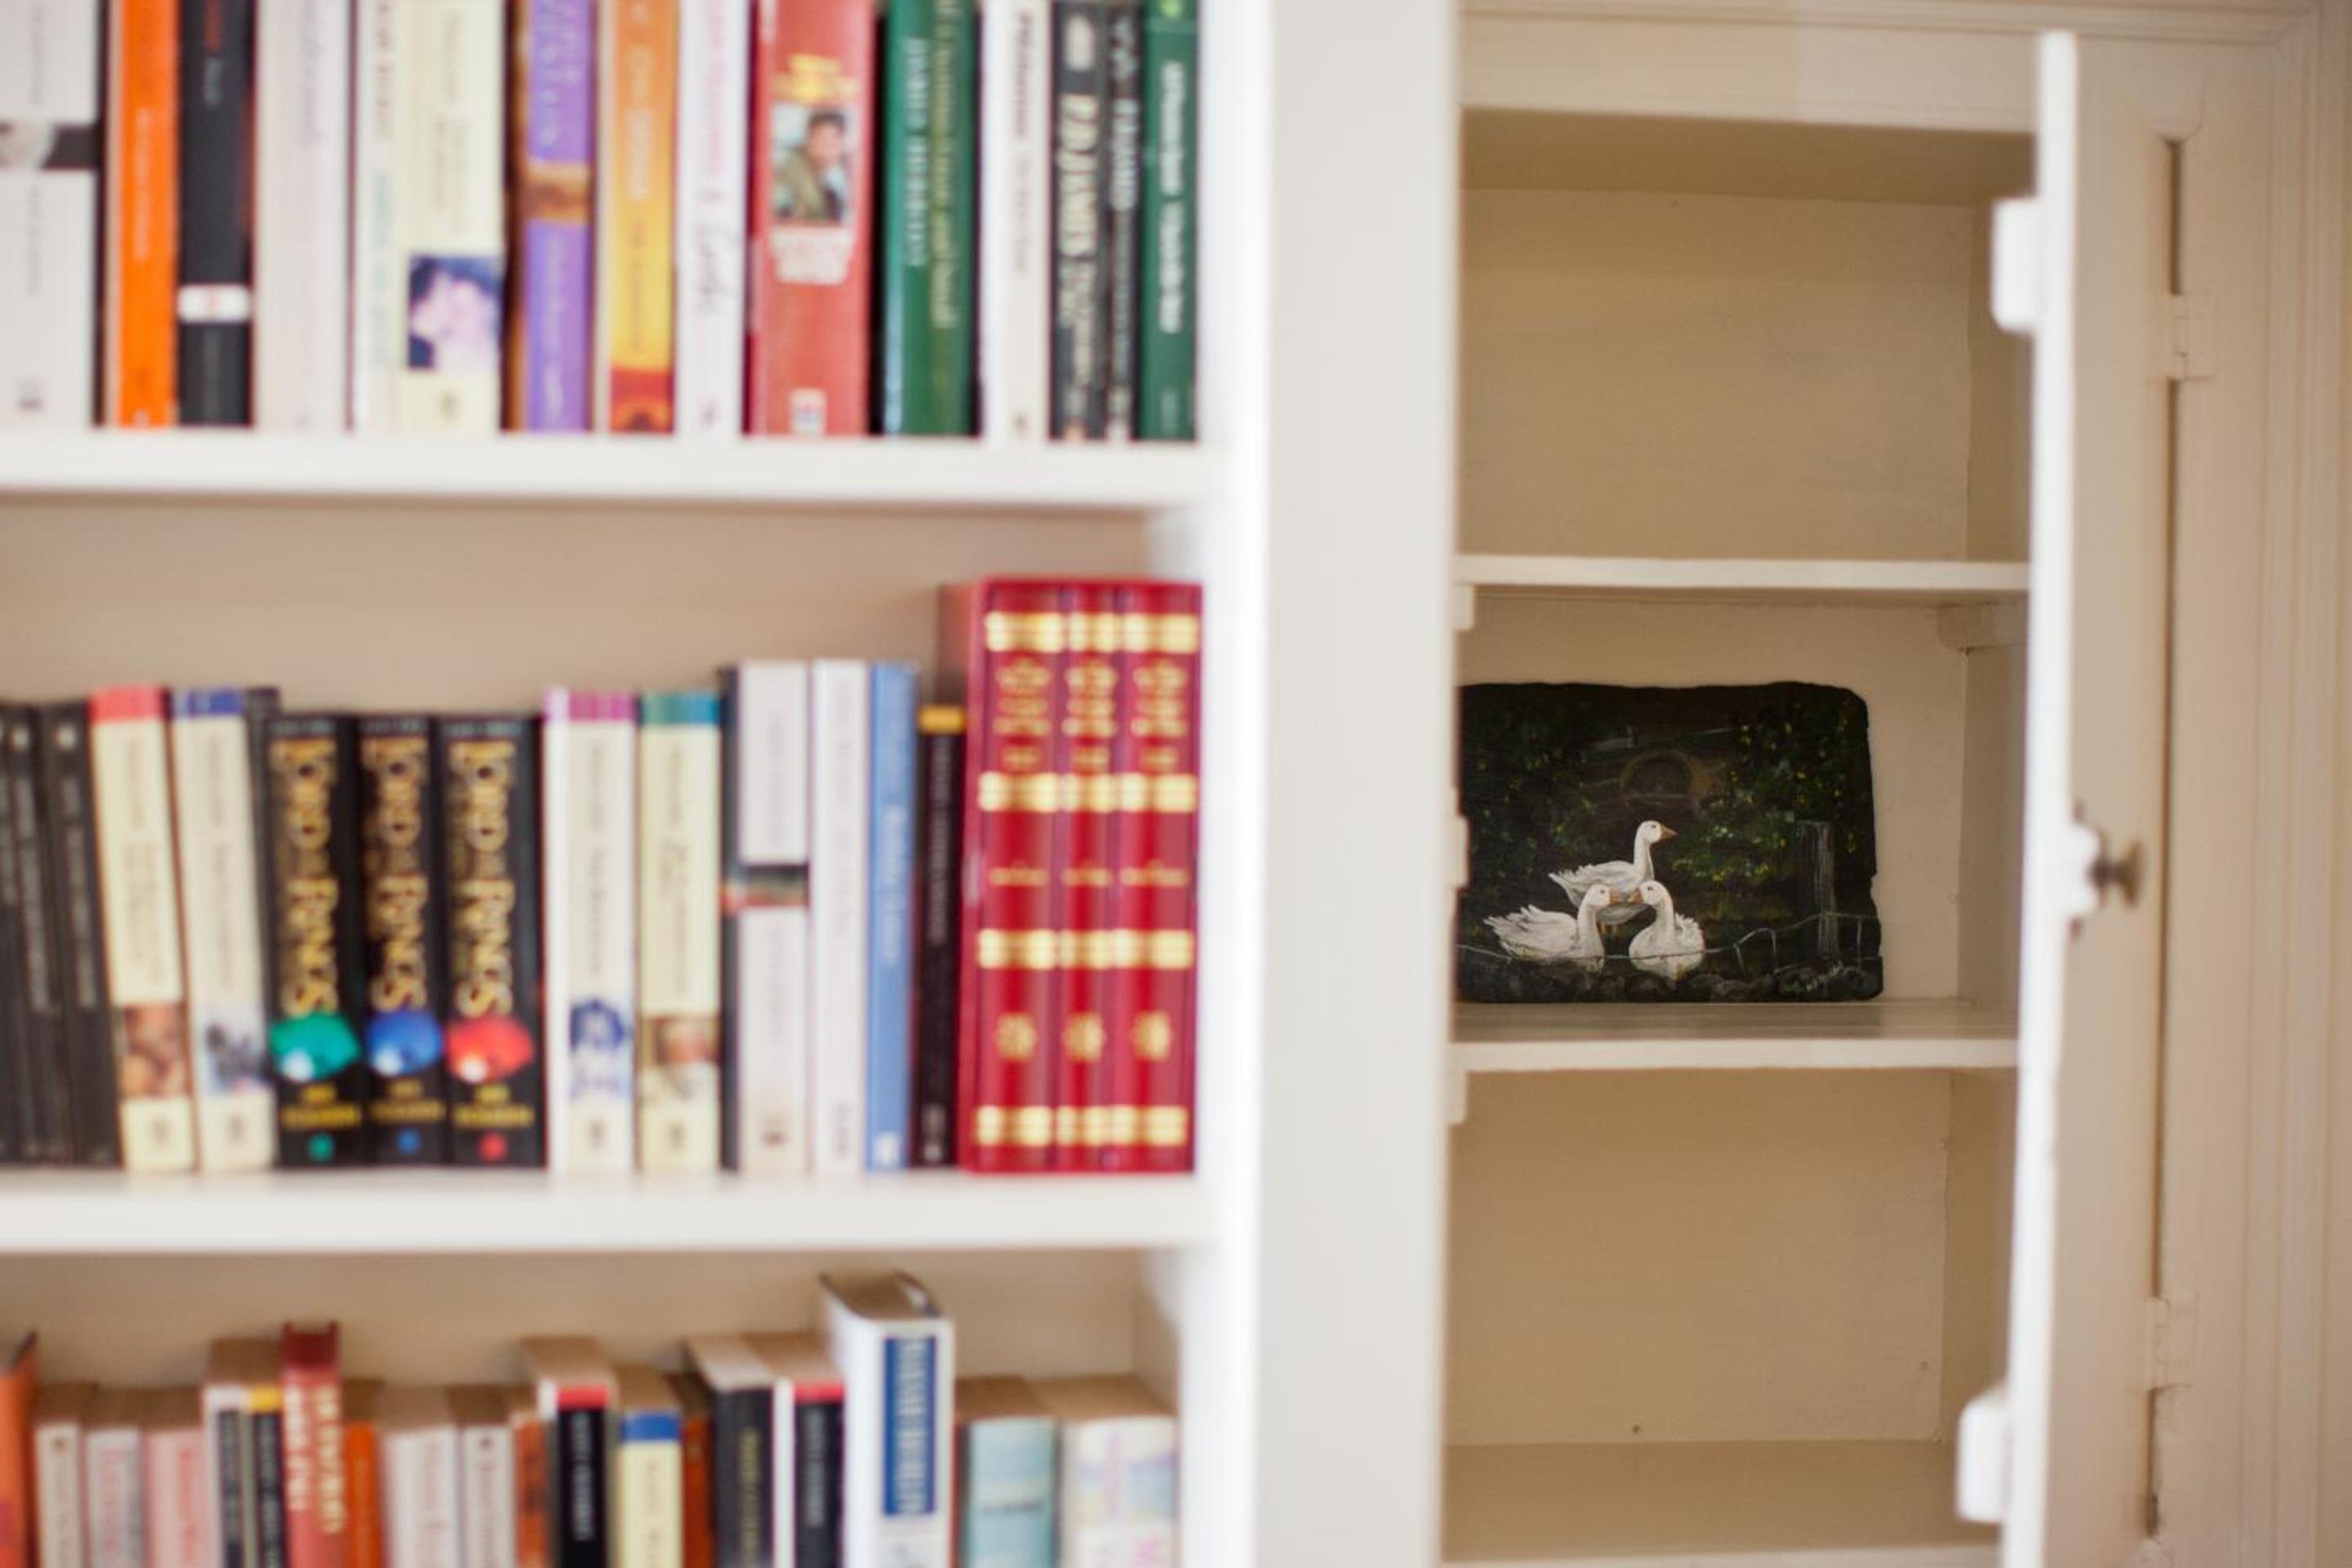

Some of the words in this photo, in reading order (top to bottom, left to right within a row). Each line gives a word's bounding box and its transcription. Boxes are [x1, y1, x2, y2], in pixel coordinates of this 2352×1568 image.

[269, 739, 336, 849] LORD
[362, 737, 429, 846] LORD
[449, 741, 516, 851] LORD
[282, 878, 340, 1017] RINGS
[370, 875, 430, 1013] RINGS
[456, 879, 517, 1017] RINGS
